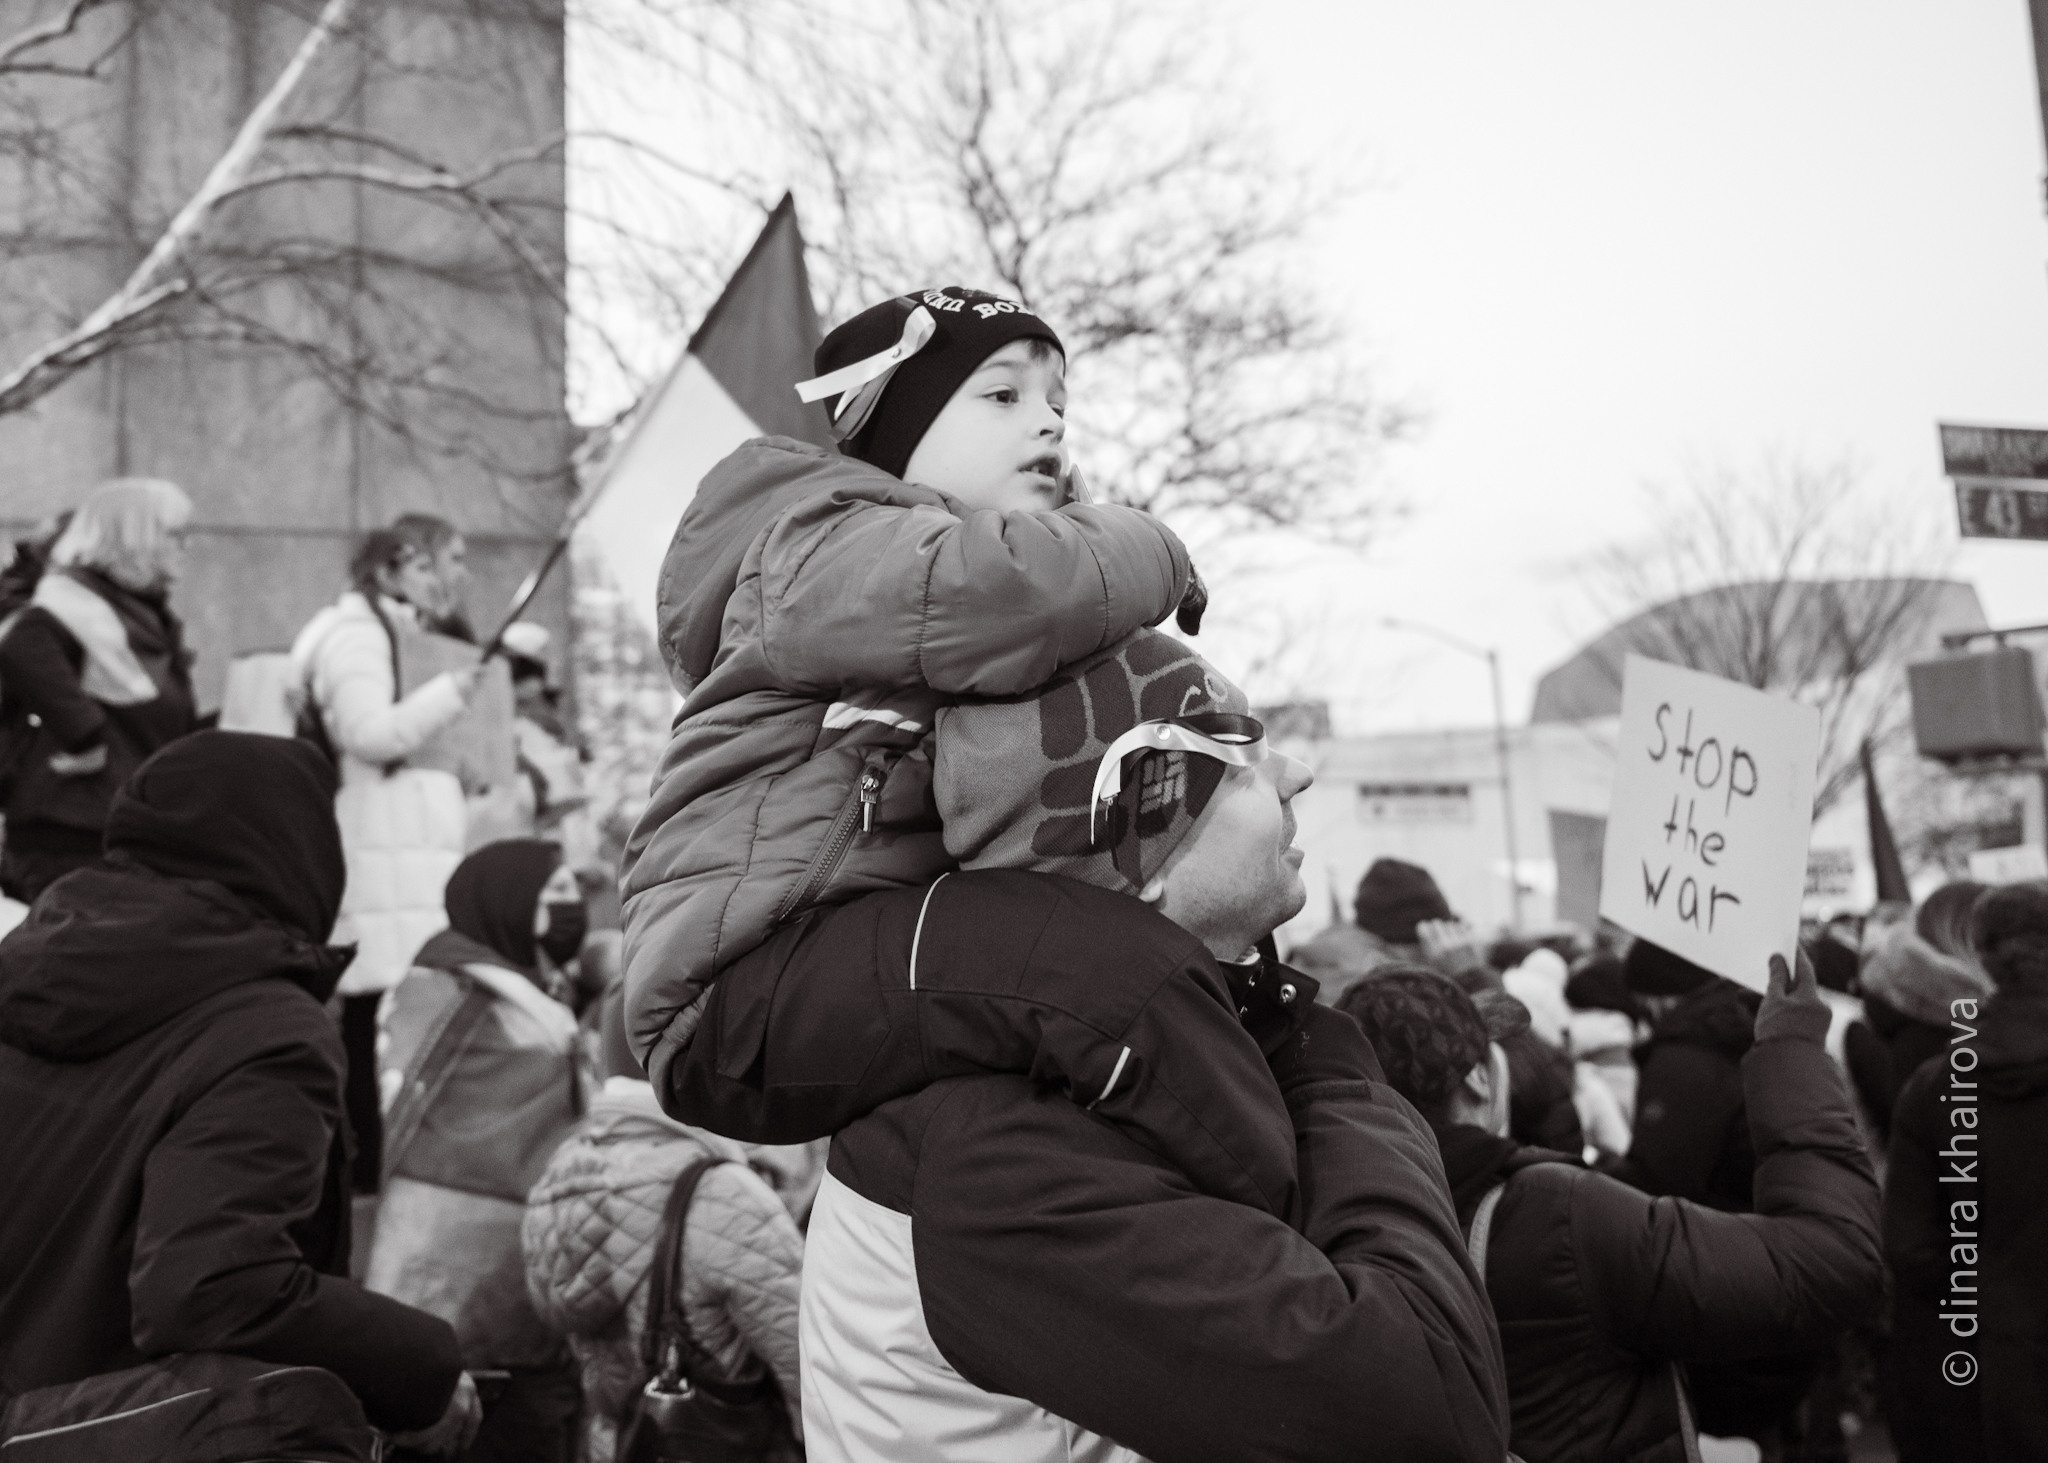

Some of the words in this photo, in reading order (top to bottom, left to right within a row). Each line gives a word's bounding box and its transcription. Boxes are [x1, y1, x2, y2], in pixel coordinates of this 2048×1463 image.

[1648, 702, 1758, 817] Stop
[1664, 793, 1726, 866] the
[1642, 856, 1741, 933] war
